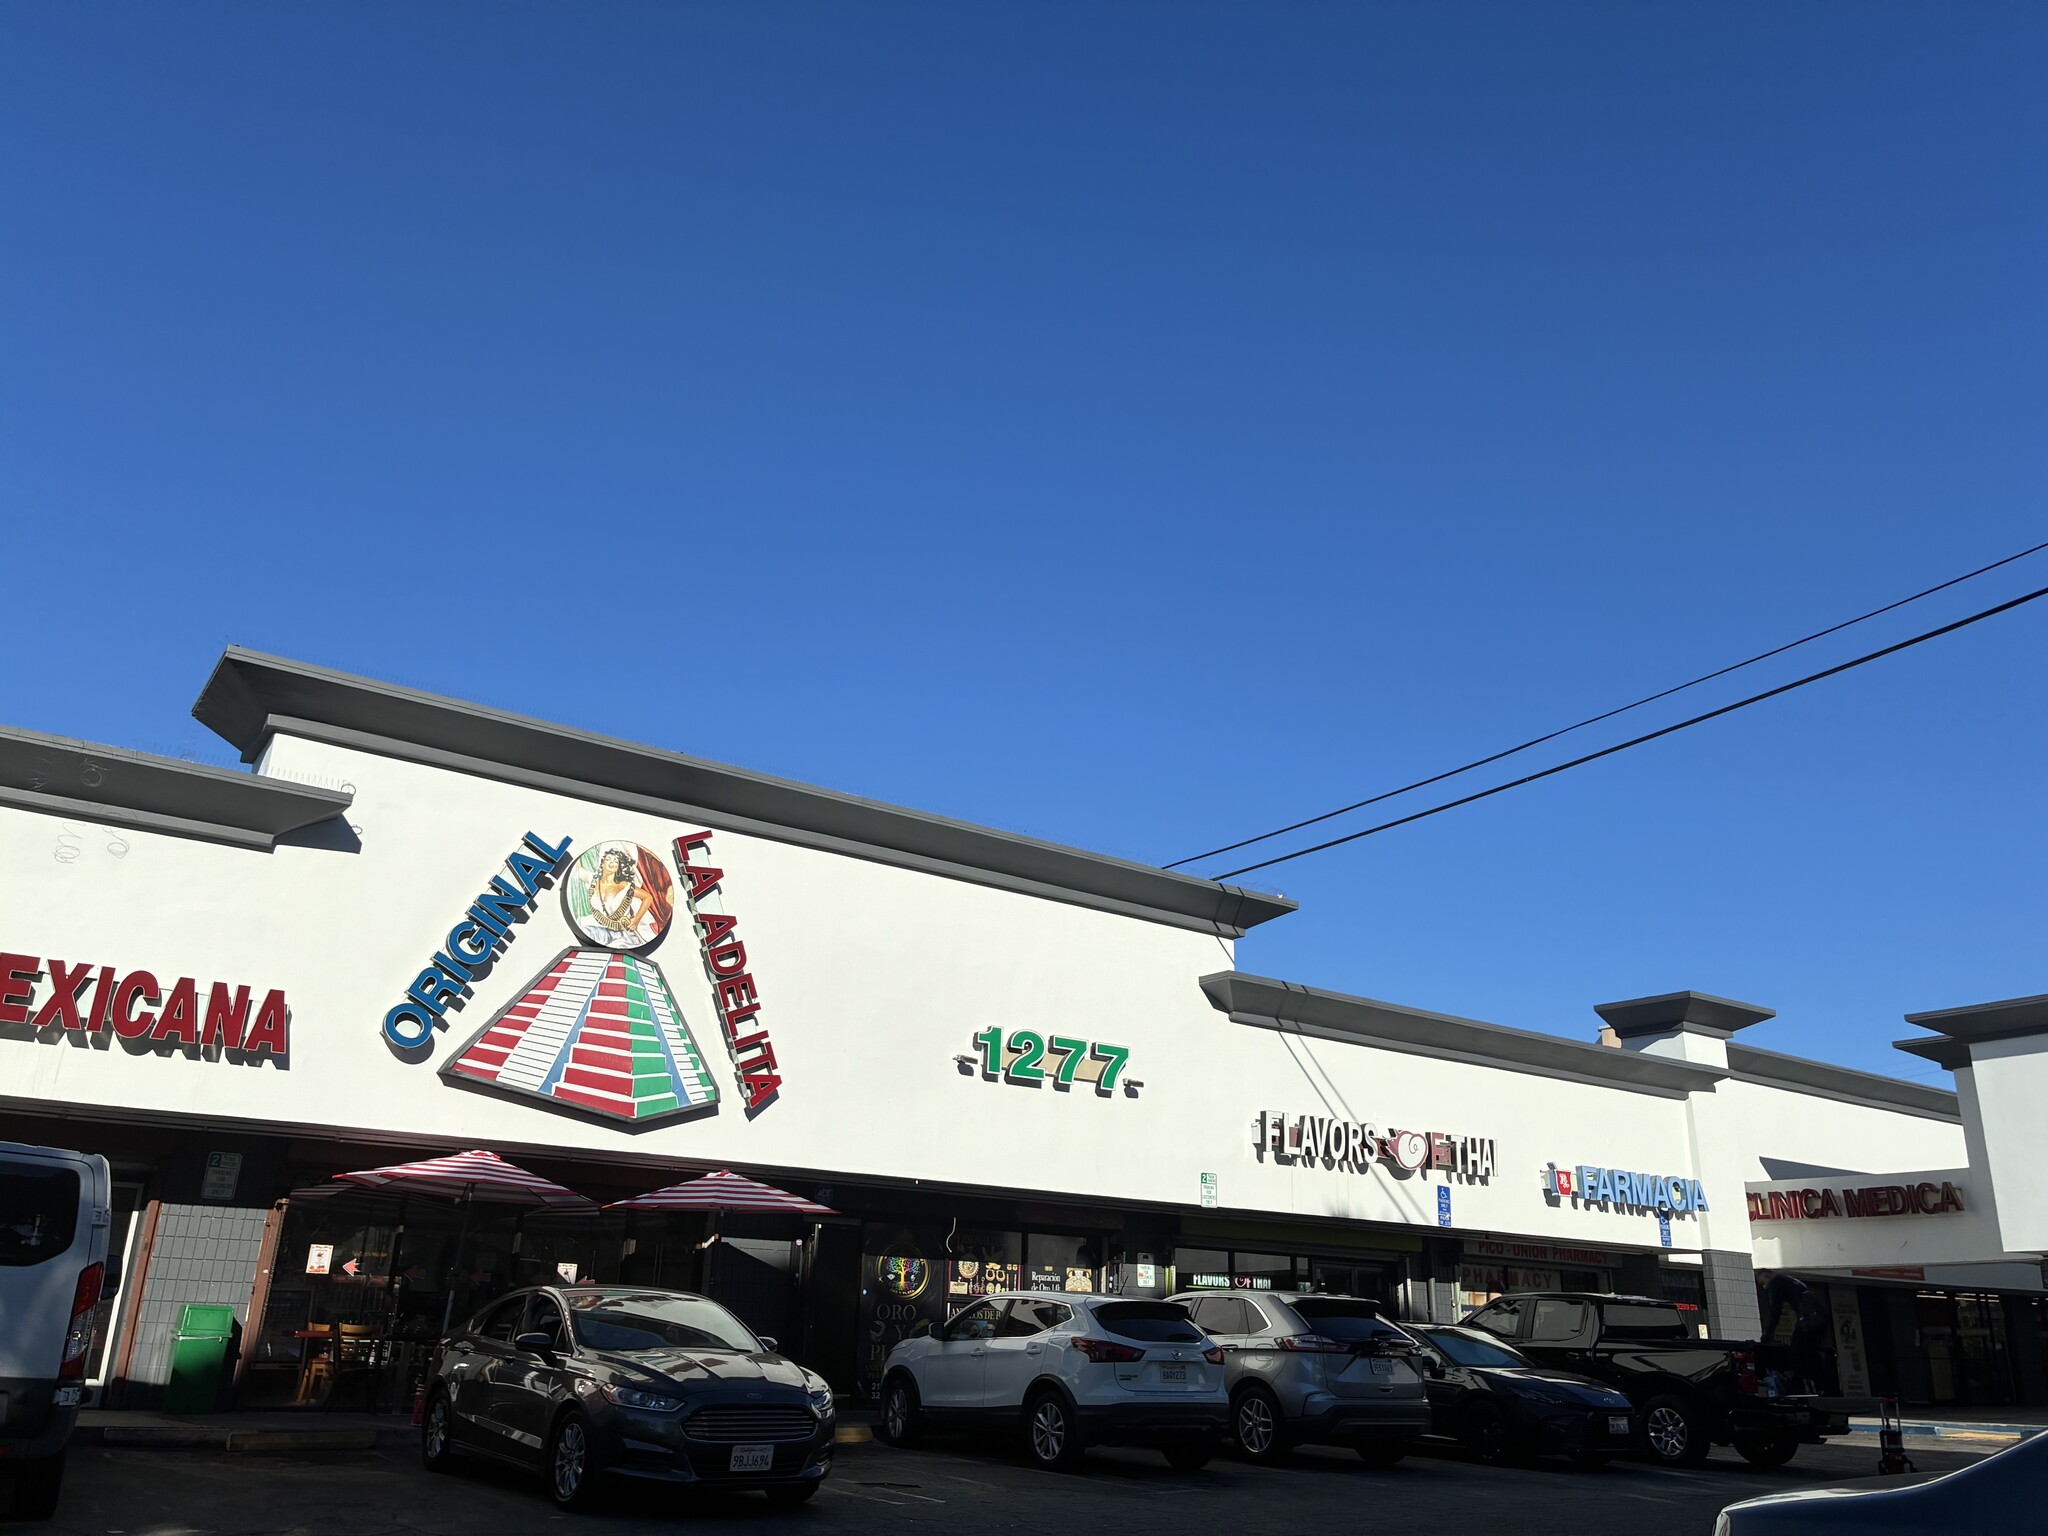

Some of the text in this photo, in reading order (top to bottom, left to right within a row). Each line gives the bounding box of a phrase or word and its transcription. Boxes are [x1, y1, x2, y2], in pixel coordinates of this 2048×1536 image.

[382, 829, 574, 1050] ORIGINAL
[675, 829, 783, 1109] LA ADELITA
[975, 1025, 1131, 1092] 1277
[1260, 1109, 1379, 1165] FLAVORS
[1448, 1133, 1498, 1177] THAI
[212, 1154, 220, 1166] 2
[1576, 1165, 1710, 1213] FARMACIA
[1842, 1181, 1965, 1218] MEDICA
[1478, 1241, 1504, 1255] PICO
[1513, 1244, 1547, 1260] UNION
[1553, 1247, 1608, 1265] PHARMACY
[1193, 1273, 1230, 1288] FLAVORS
[1462, 1266, 1552, 1289] PHARMACY
[876, 1303, 917, 1321] ORO
[732, 1454, 770, 1468] 9BJJ694
